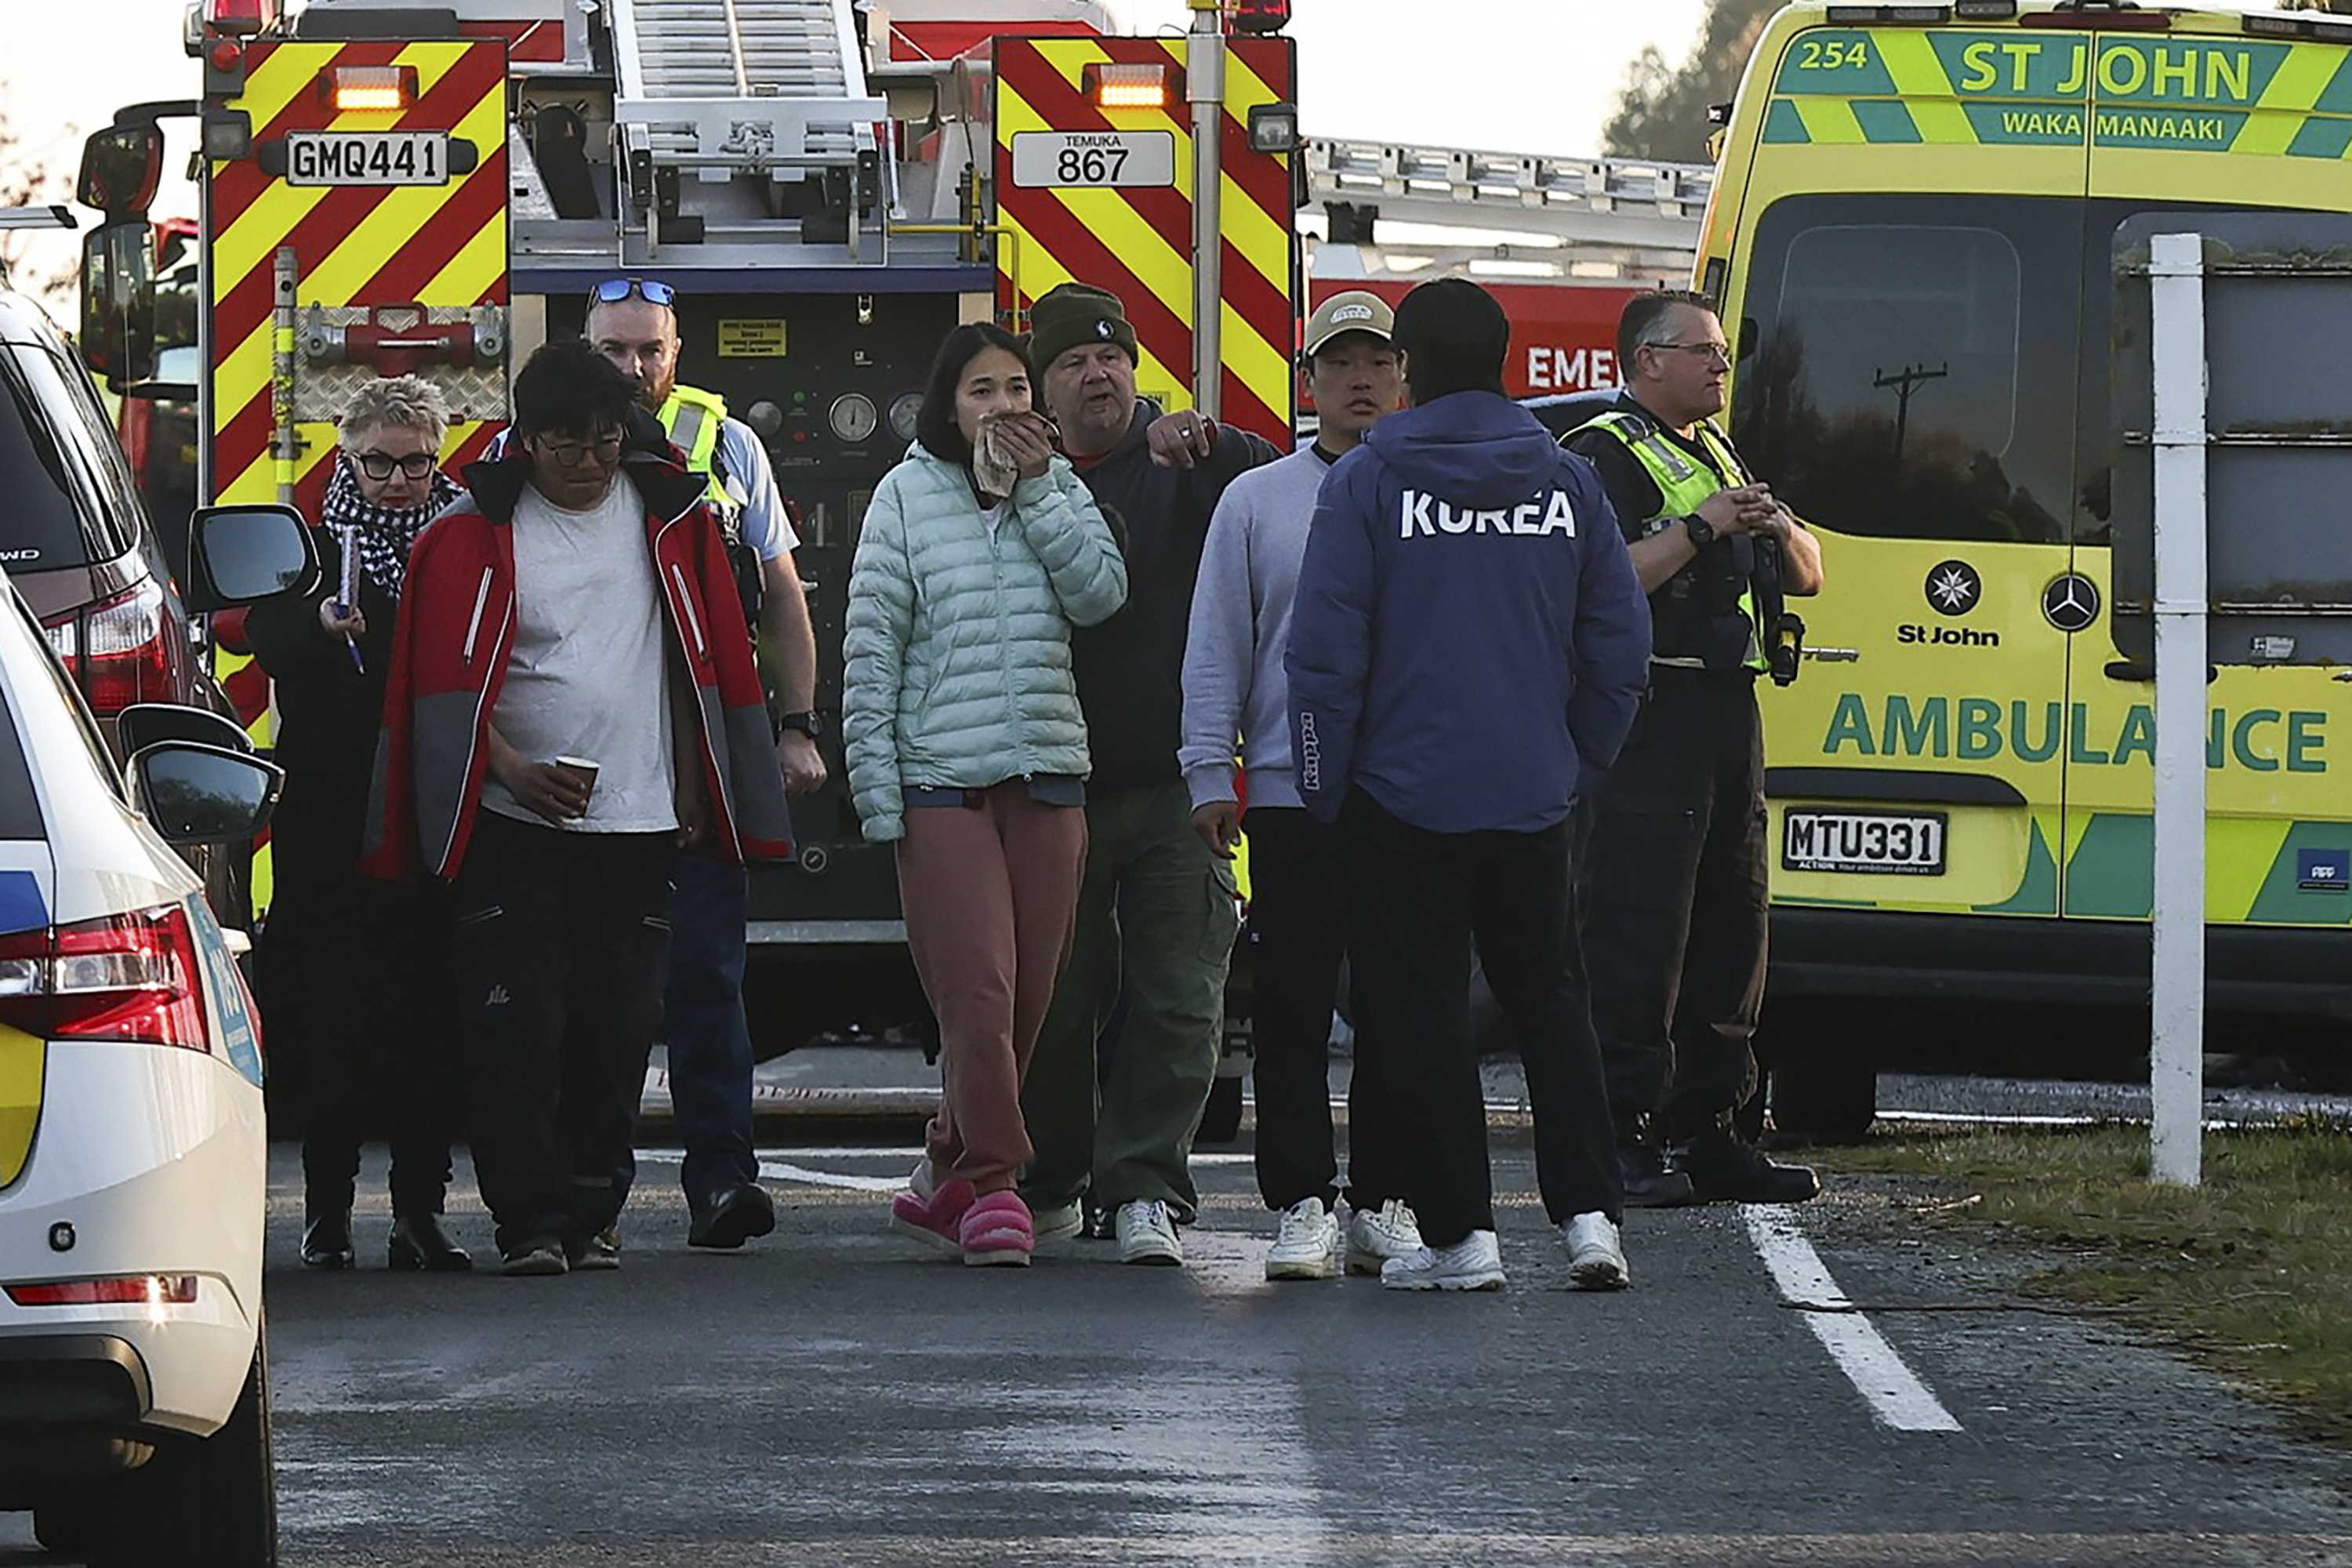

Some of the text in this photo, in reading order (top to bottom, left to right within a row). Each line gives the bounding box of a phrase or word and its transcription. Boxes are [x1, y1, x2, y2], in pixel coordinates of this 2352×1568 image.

[1799, 42, 1867, 69] 254
[1961, 42, 2250, 100] ST JOHN
[1065, 135, 1122, 147] TEMUKA
[2002, 113, 2223, 140] WAKA MANAAKI
[293, 140, 436, 177] GMQ441
[1058, 149, 1129, 183] 867
[1527, 347, 1625, 390] EME
[1897, 624, 2000, 647] St John
[1301, 712, 1320, 790] Kappa
[1791, 818, 1931, 862] MTU331
[1798, 861, 1835, 870] ACTION
